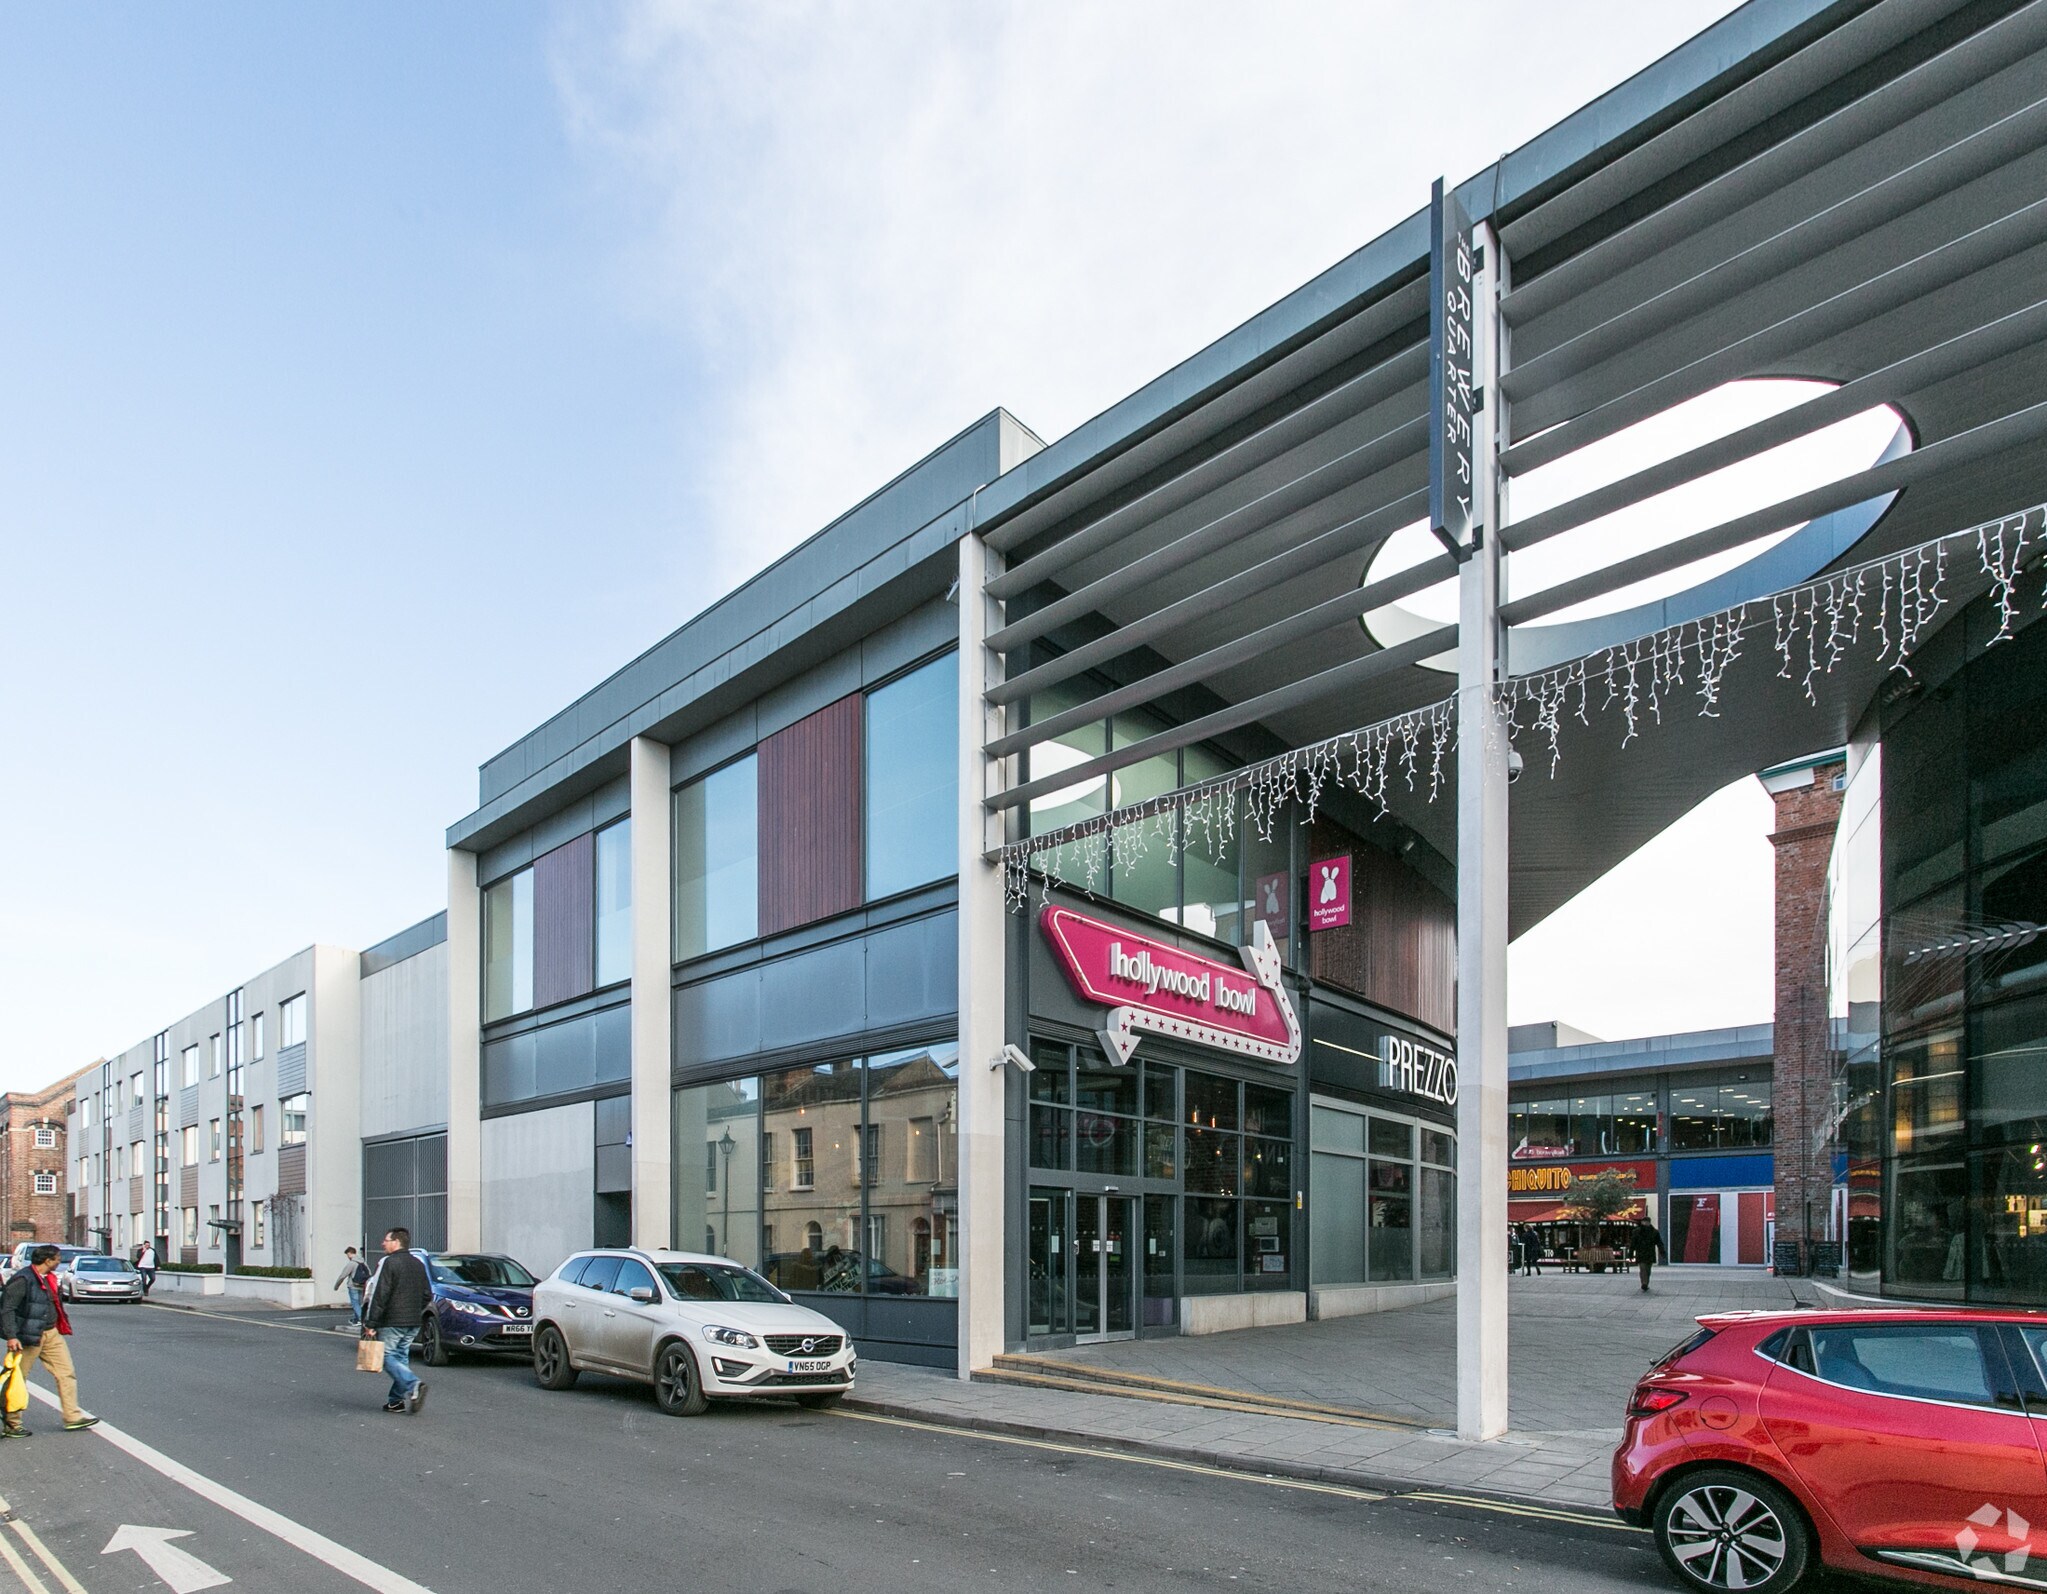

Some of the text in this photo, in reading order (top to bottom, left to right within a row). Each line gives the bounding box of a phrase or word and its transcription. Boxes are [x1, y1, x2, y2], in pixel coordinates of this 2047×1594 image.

[1457, 231, 1471, 258] THE
[1447, 290, 1457, 444] QUARTER
[1456, 247, 1471, 521] BREWERY
[1313, 904, 1345, 918] hollywood
[1321, 915, 1338, 925] bowl
[1110, 941, 1256, 1016] hollywood bowl
[1384, 1034, 1458, 1106] PREZZO
[794, 1361, 831, 1371] VN65 OGP
